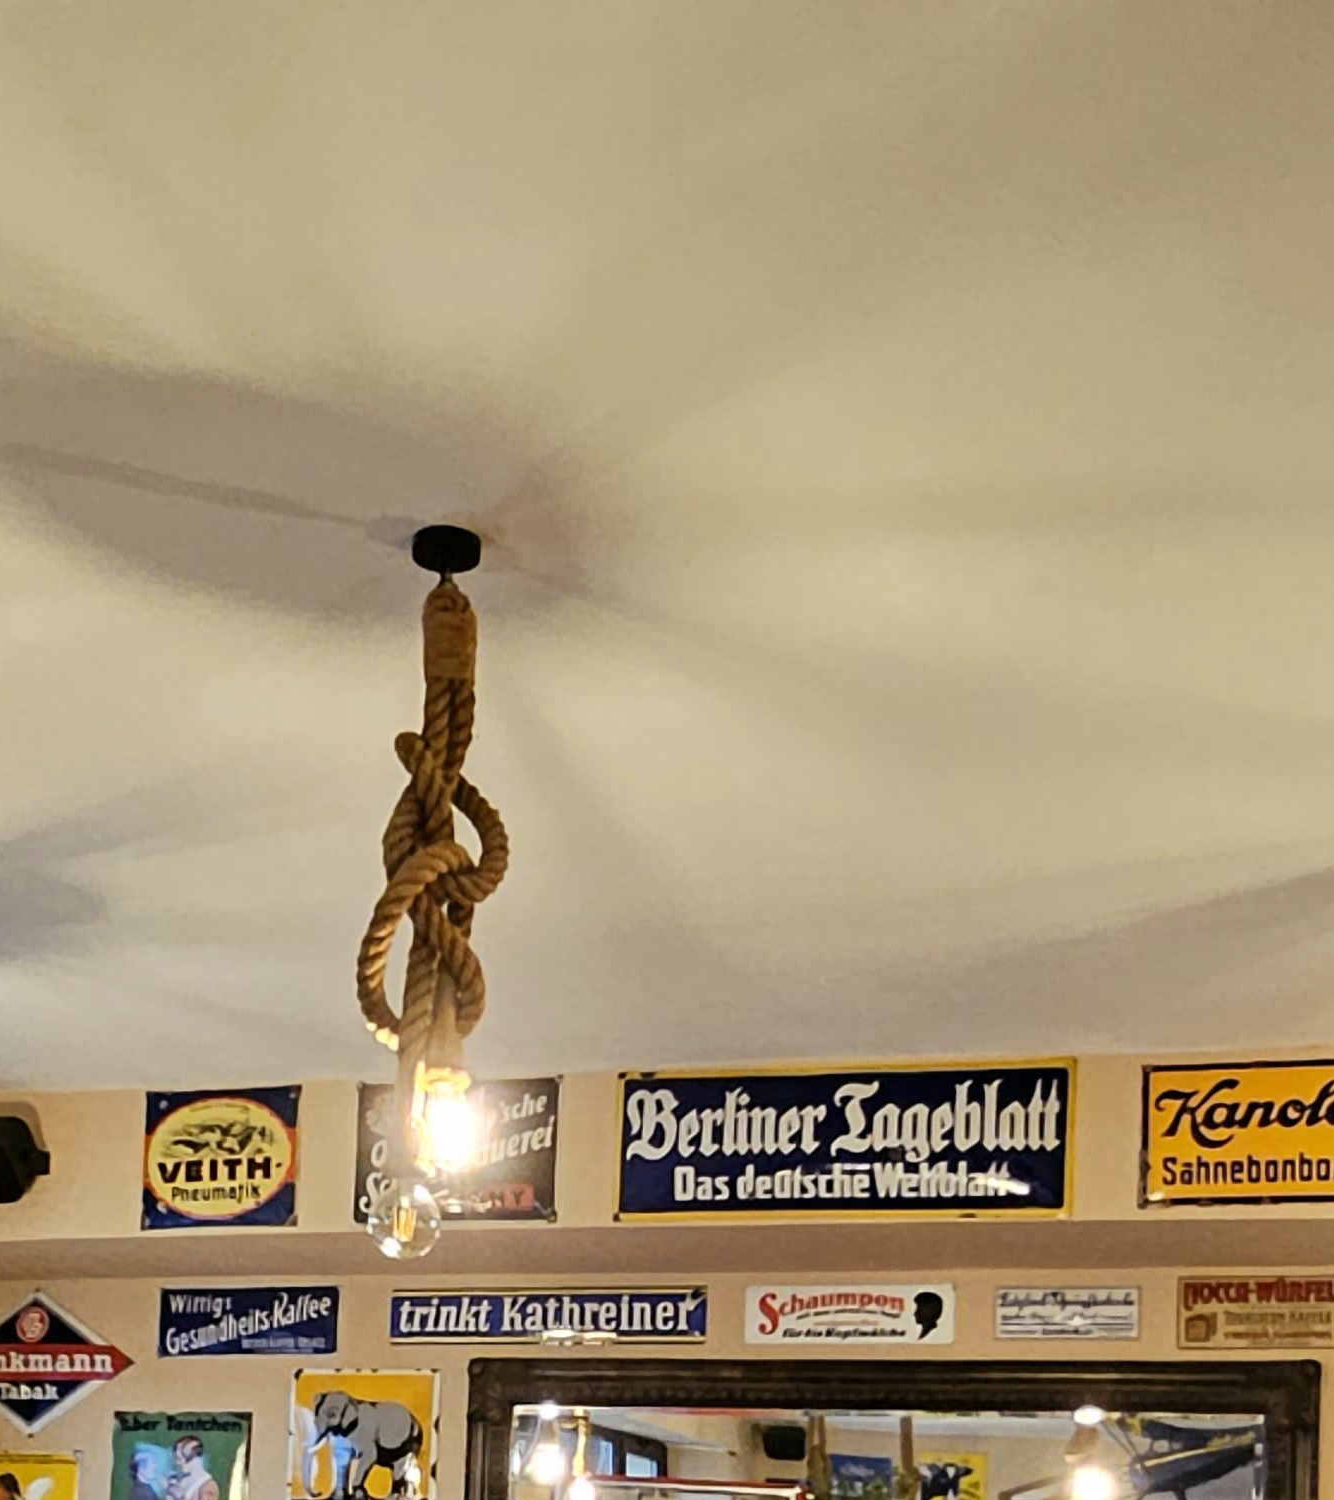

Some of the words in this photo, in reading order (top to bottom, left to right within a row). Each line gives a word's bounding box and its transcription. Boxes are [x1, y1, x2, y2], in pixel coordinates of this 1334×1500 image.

[626, 1086, 827, 1161] Berliner
[830, 1078, 1061, 1162] Tageblatt
[171, 1182, 261, 1204] Pneumatik
[674, 1166, 730, 1201] Das
[736, 1163, 870, 1200] deutsche
[399, 1297, 493, 1333] trinkt
[500, 1294, 699, 1333] Kathreiner
[758, 1292, 905, 1336] Schaumpon
